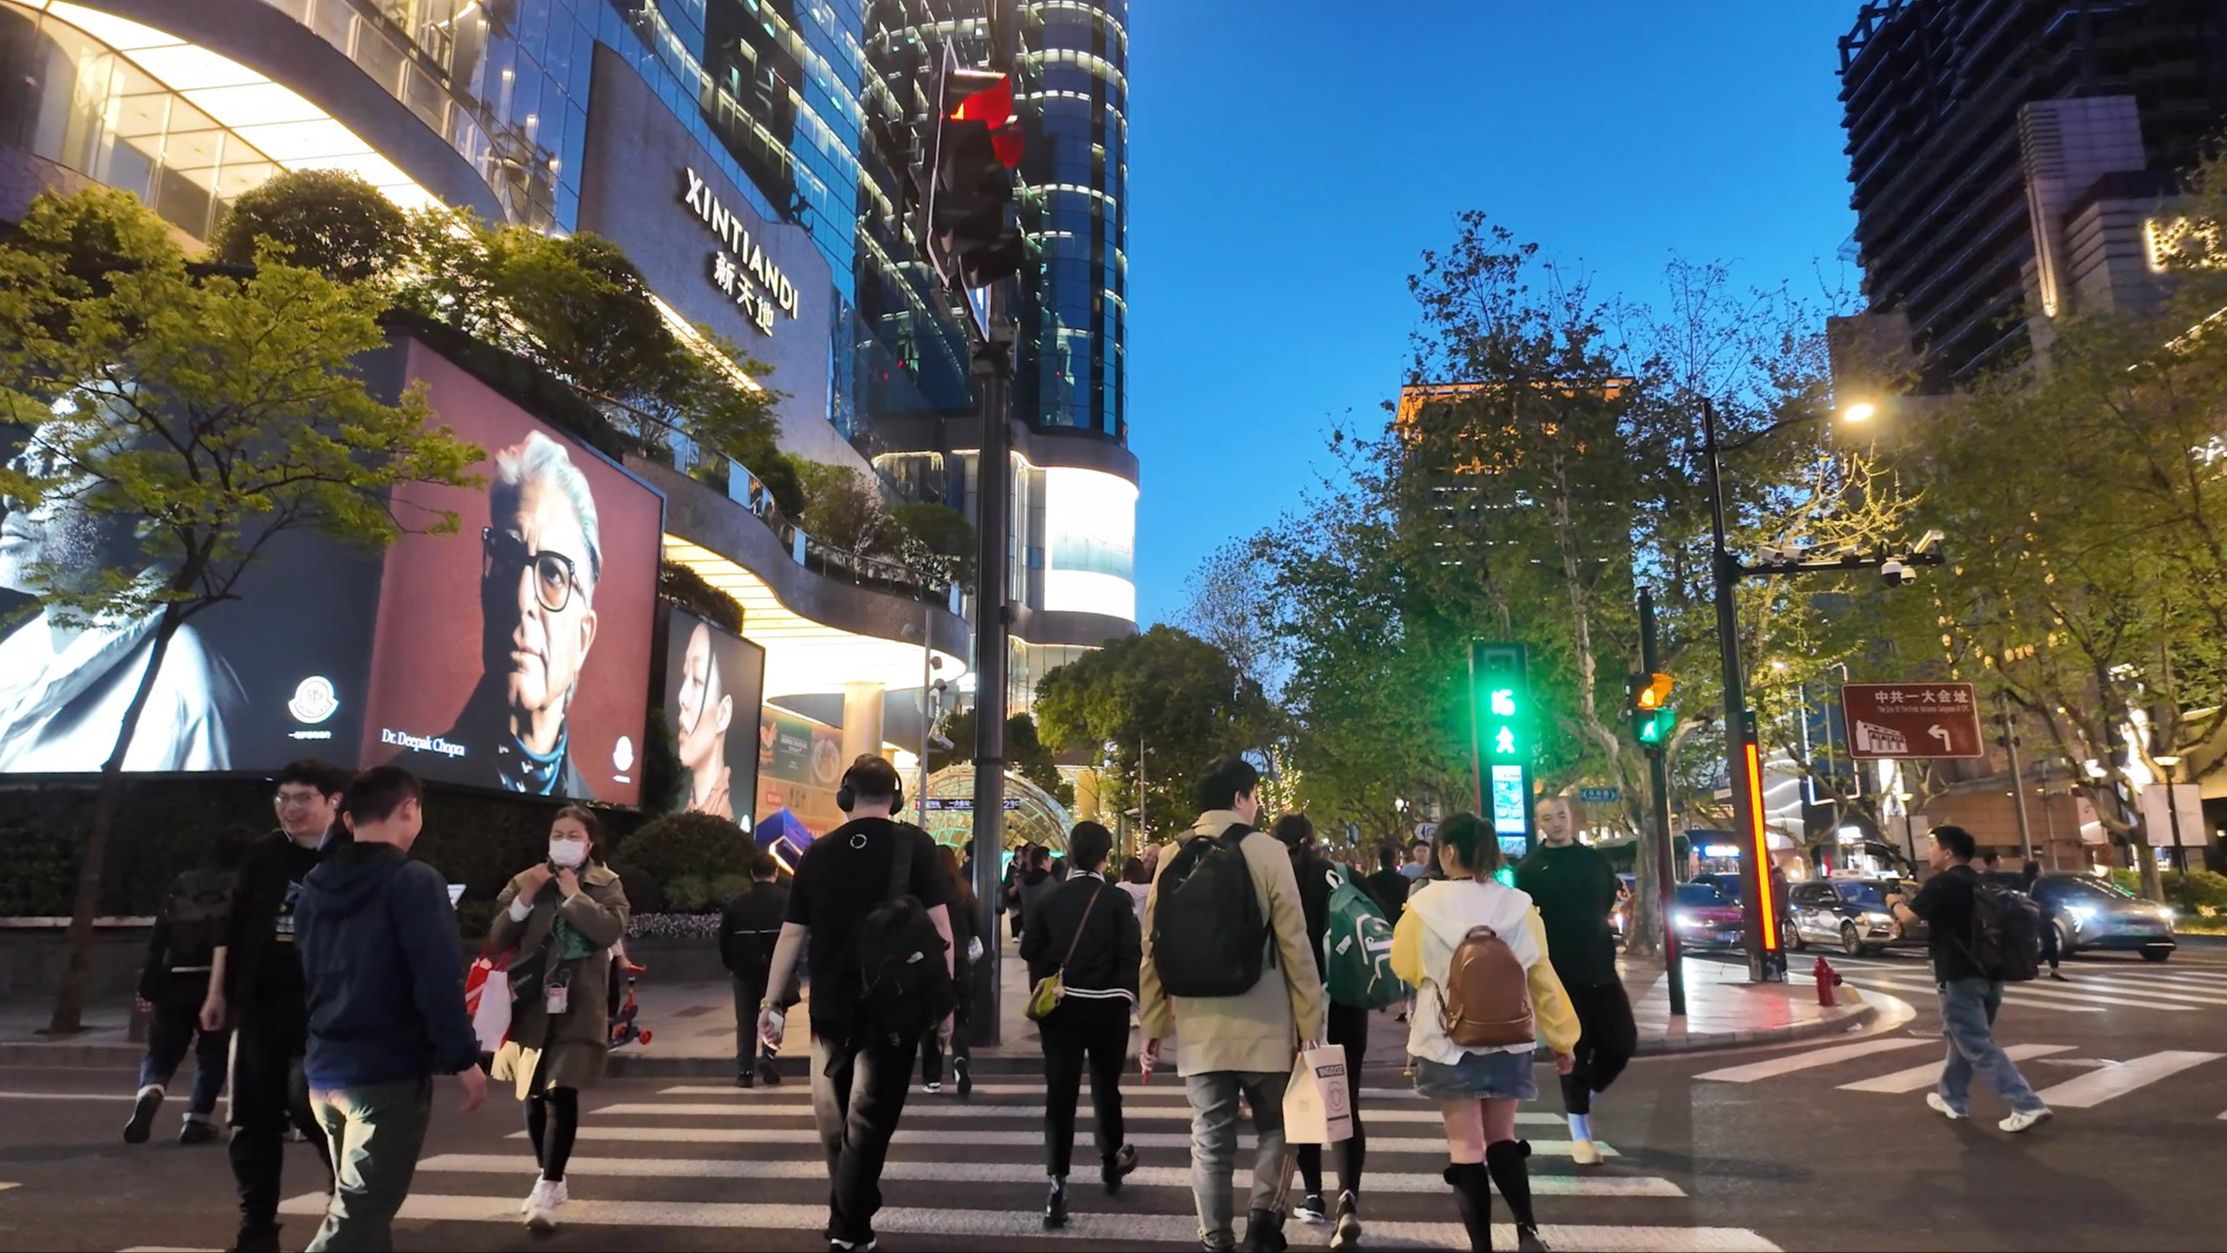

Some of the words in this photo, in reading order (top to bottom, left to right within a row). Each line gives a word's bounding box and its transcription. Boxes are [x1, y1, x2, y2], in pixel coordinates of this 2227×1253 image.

[685, 166, 799, 320] XINTIANDI
[713, 250, 774, 338] 新天地
[1875, 690, 1969, 704] 中共一大会址
[382, 728, 396, 744] Dr.
[398, 731, 432, 752] Deepak
[432, 738, 465, 758] Chopra
